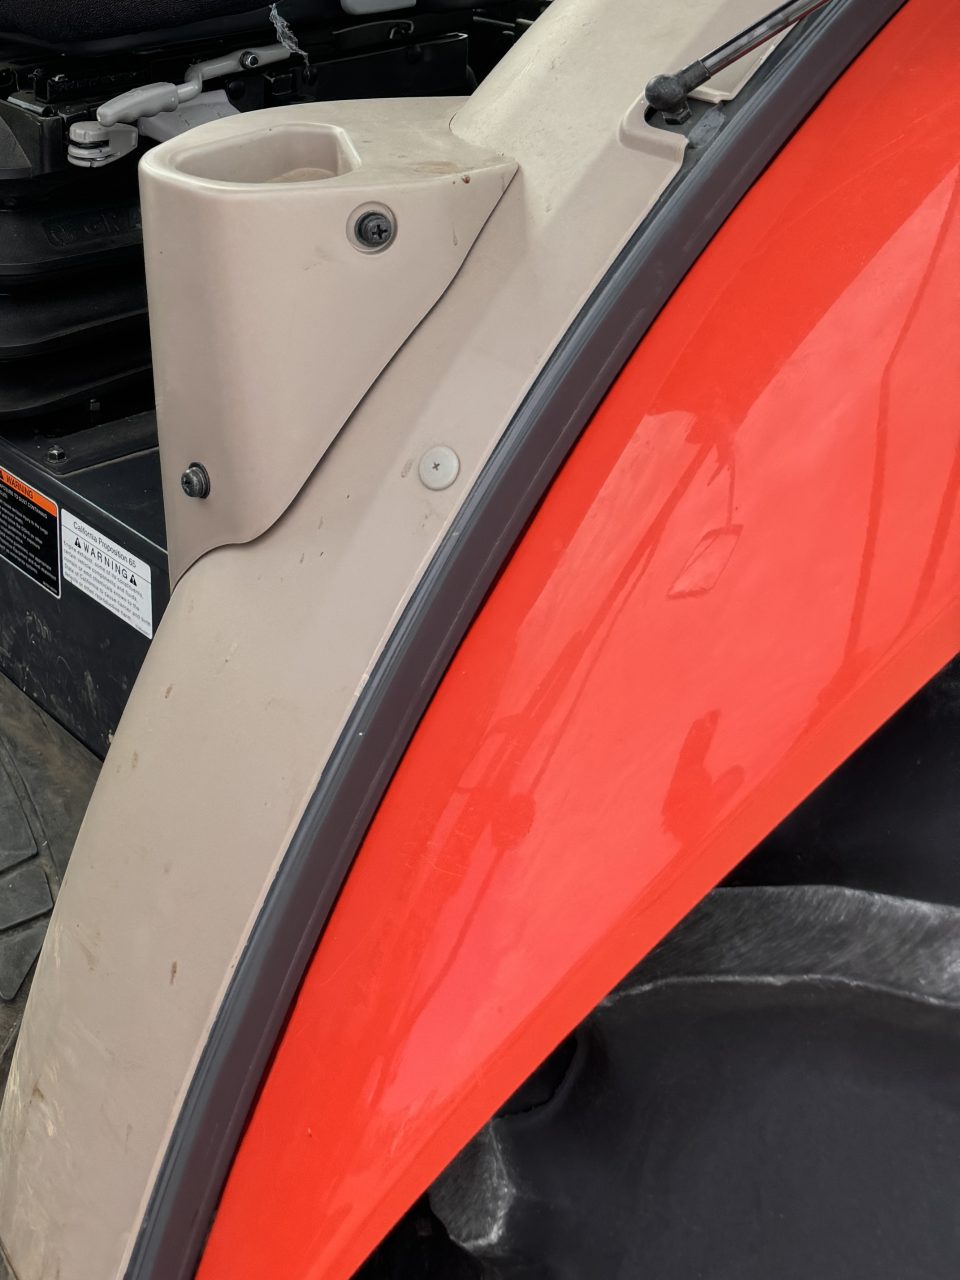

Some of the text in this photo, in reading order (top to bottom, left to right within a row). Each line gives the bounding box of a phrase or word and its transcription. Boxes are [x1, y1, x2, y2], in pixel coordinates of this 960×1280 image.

[6, 474, 32, 499] WARNING
[73, 520, 136, 568] California Proposition 65
[83, 542, 127, 579] WARNING
